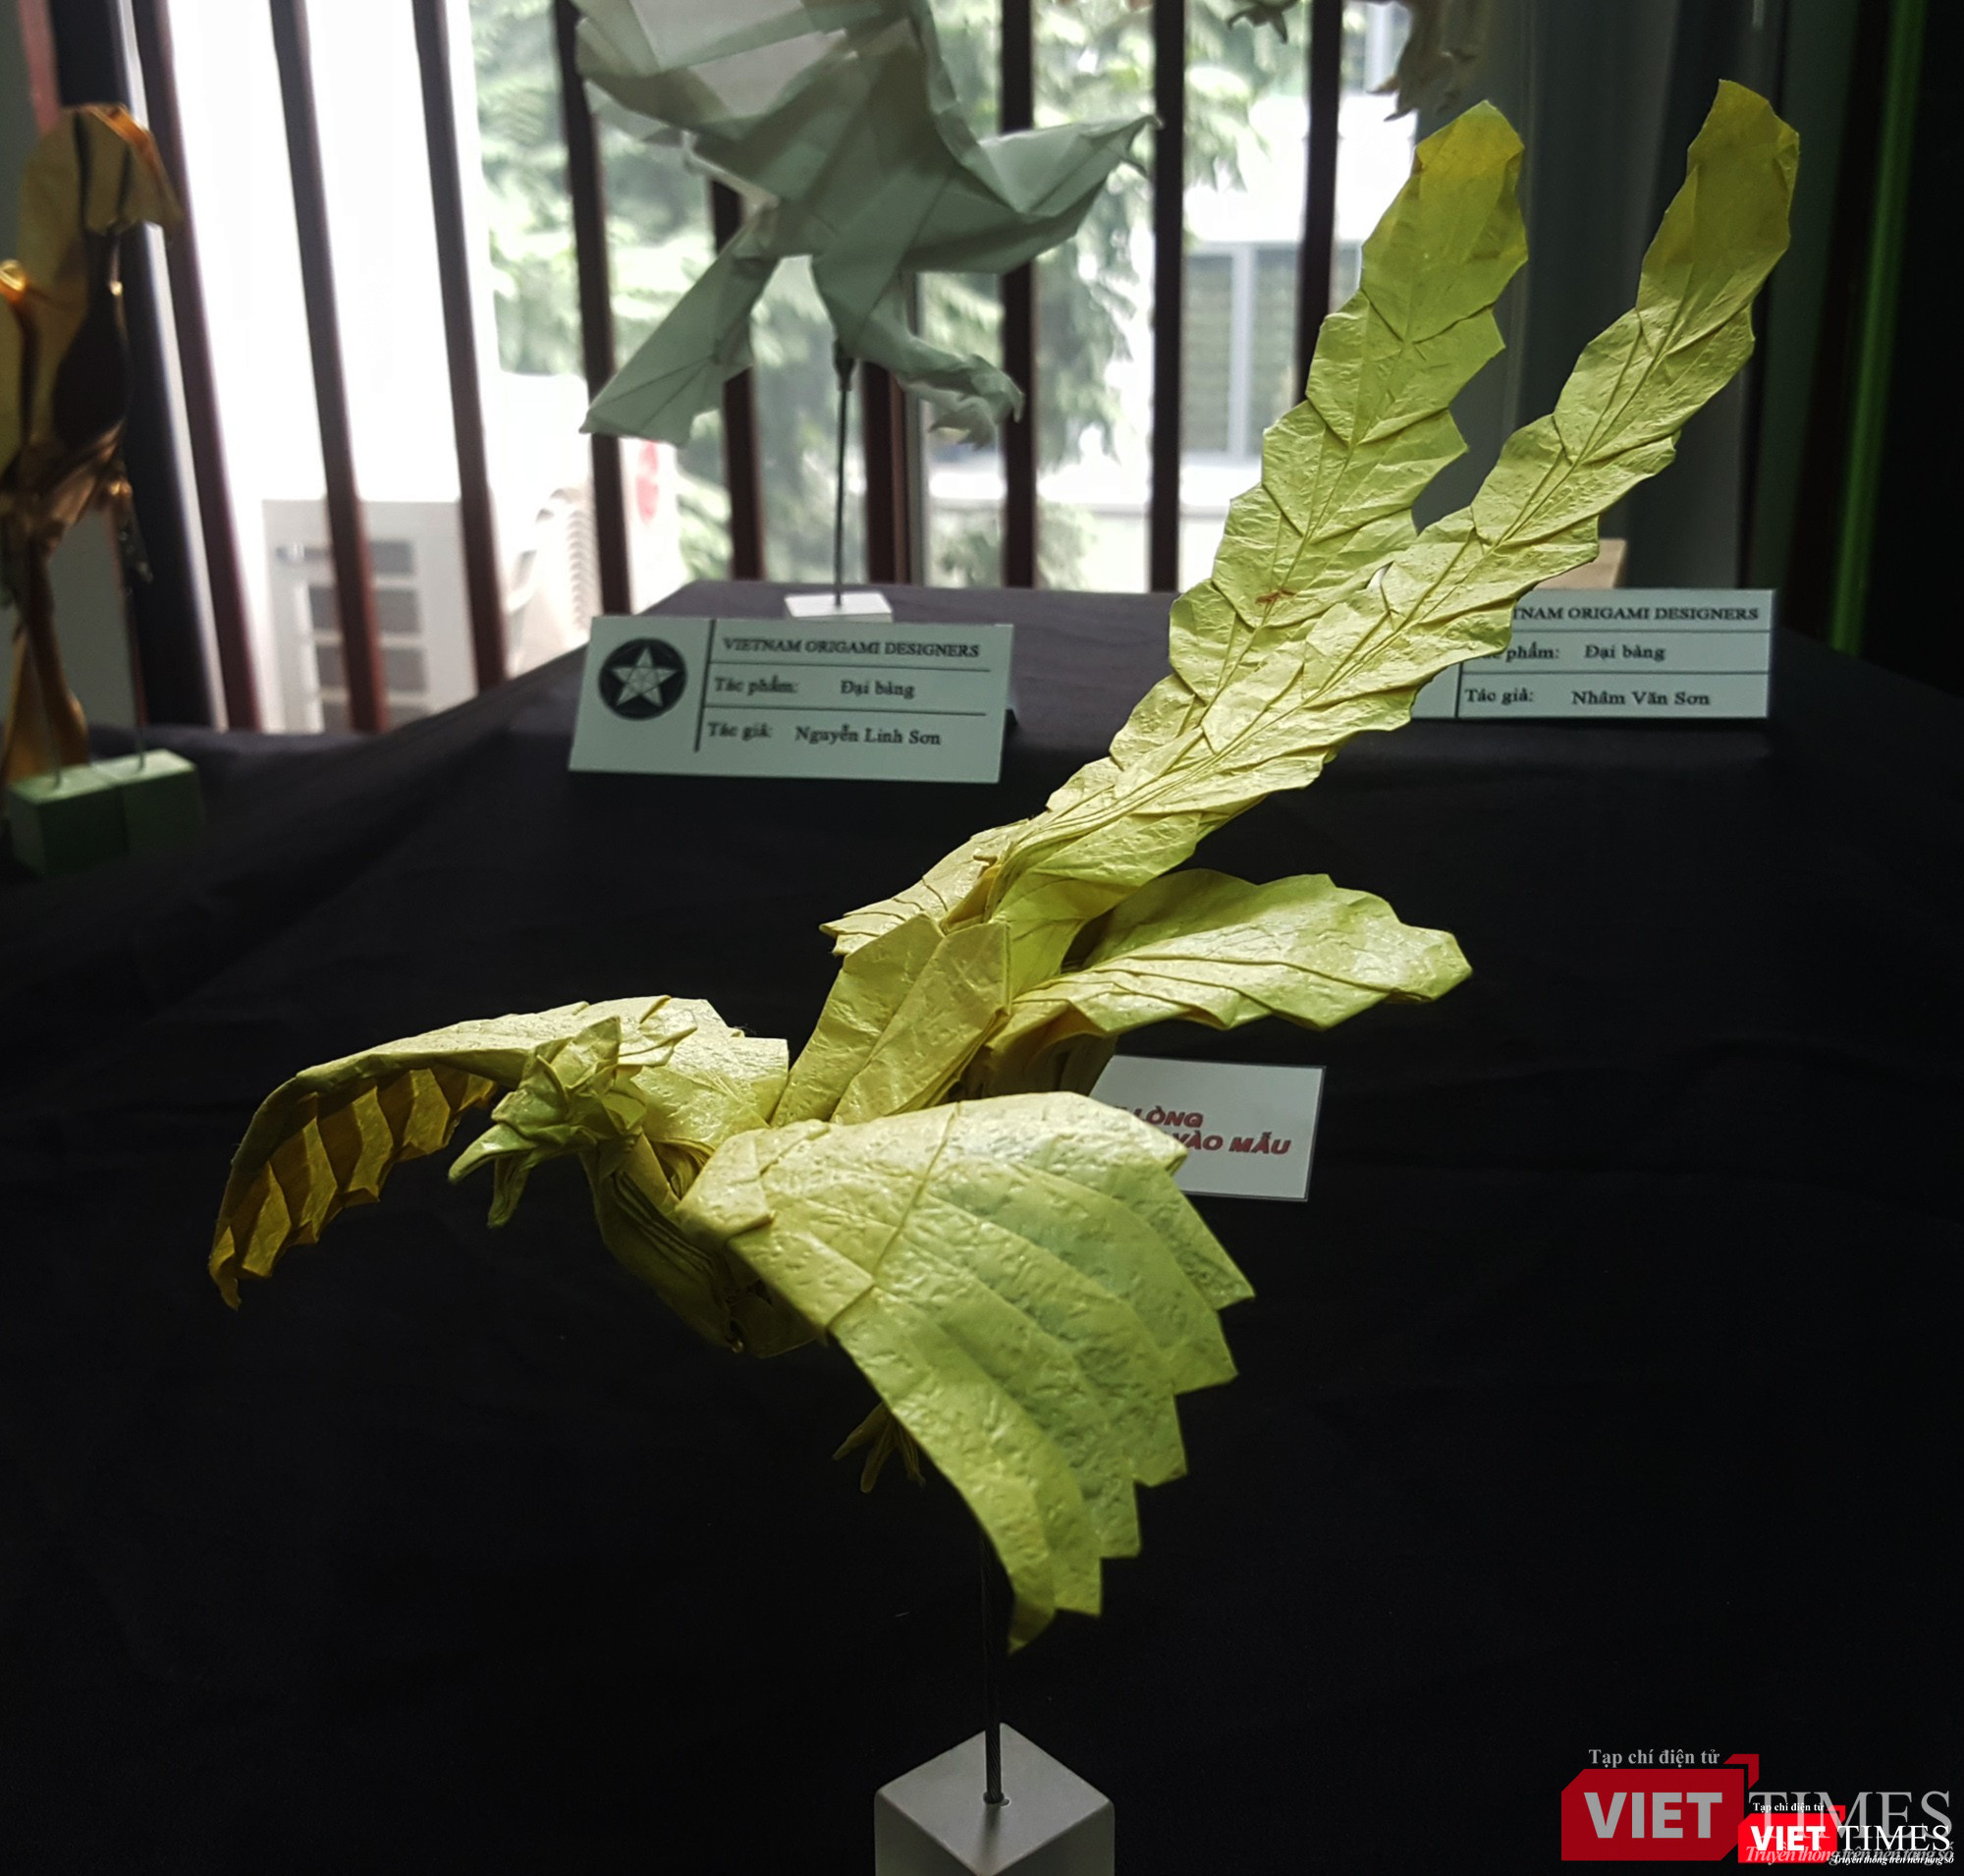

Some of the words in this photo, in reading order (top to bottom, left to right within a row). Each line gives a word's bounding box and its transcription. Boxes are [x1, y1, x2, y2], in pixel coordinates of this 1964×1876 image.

[1567, 607, 1651, 621] ORIGAMI
[1655, 607, 1760, 621] DESIGNERS
[723, 638, 803, 653] VIETNAM
[804, 640, 881, 655] ORIGAMI
[884, 641, 980, 658] DESIGNERS
[1584, 643, 1616, 661] Đại
[840, 679, 870, 697] Đại
[1464, 688, 1497, 703] Tác
[1631, 690, 1668, 706] Văn
[1673, 690, 1711, 706] Sơn
[794, 724, 859, 745] Nguyễn
[864, 727, 903, 745] Linh
[908, 729, 942, 745] Sơn
